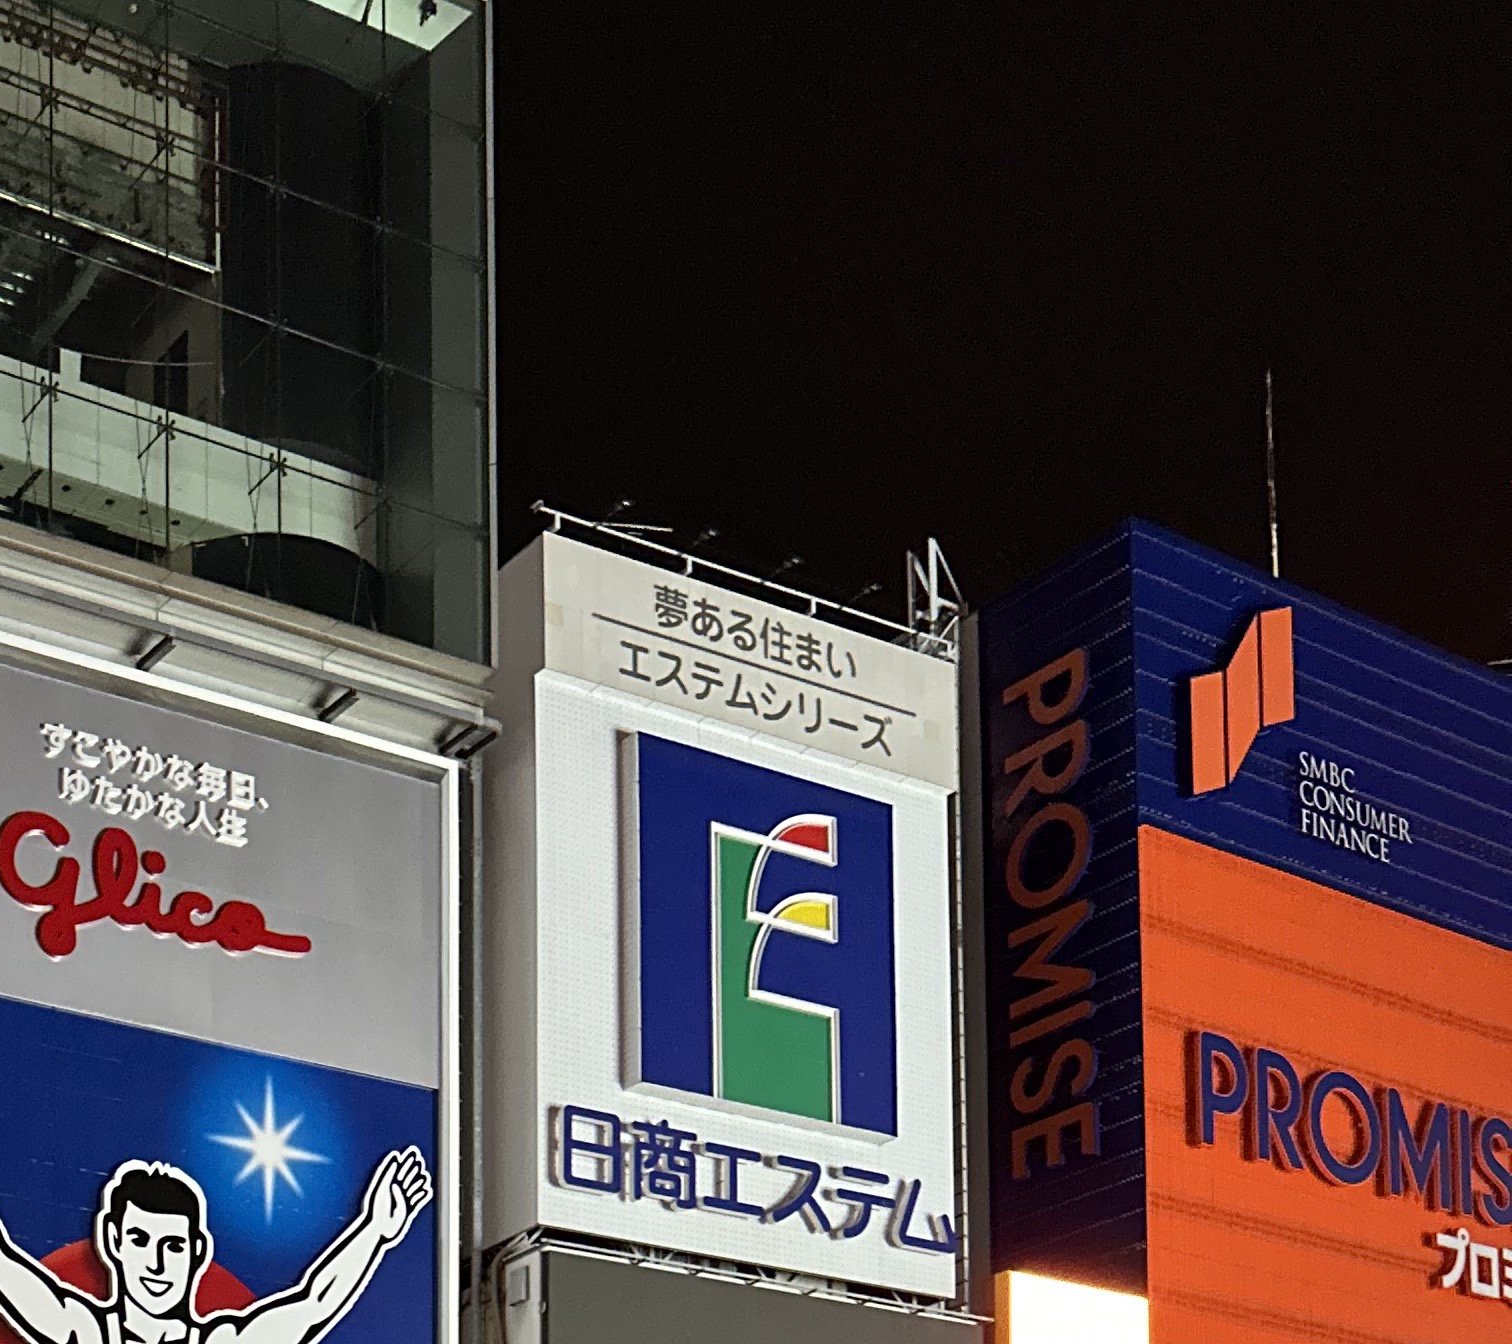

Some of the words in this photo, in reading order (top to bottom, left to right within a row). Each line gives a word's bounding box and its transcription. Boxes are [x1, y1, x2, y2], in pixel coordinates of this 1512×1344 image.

[653, 582, 858, 682] 夢ある住まい
[619, 640, 893, 757] エステムシリーズ
[39, 722, 270, 811] すこやかな毎日、
[58, 766, 249, 847] ゆたかな人生
[1299, 750, 1356, 794] SMBC
[1299, 780, 1414, 845] CONSUMER
[1300, 807, 1391, 864] FINANCE
[1003, 647, 1102, 1181] PROMISE
[1199, 1031, 1512, 1227] PROMIS
[558, 1103, 956, 1254] 日商エステム
